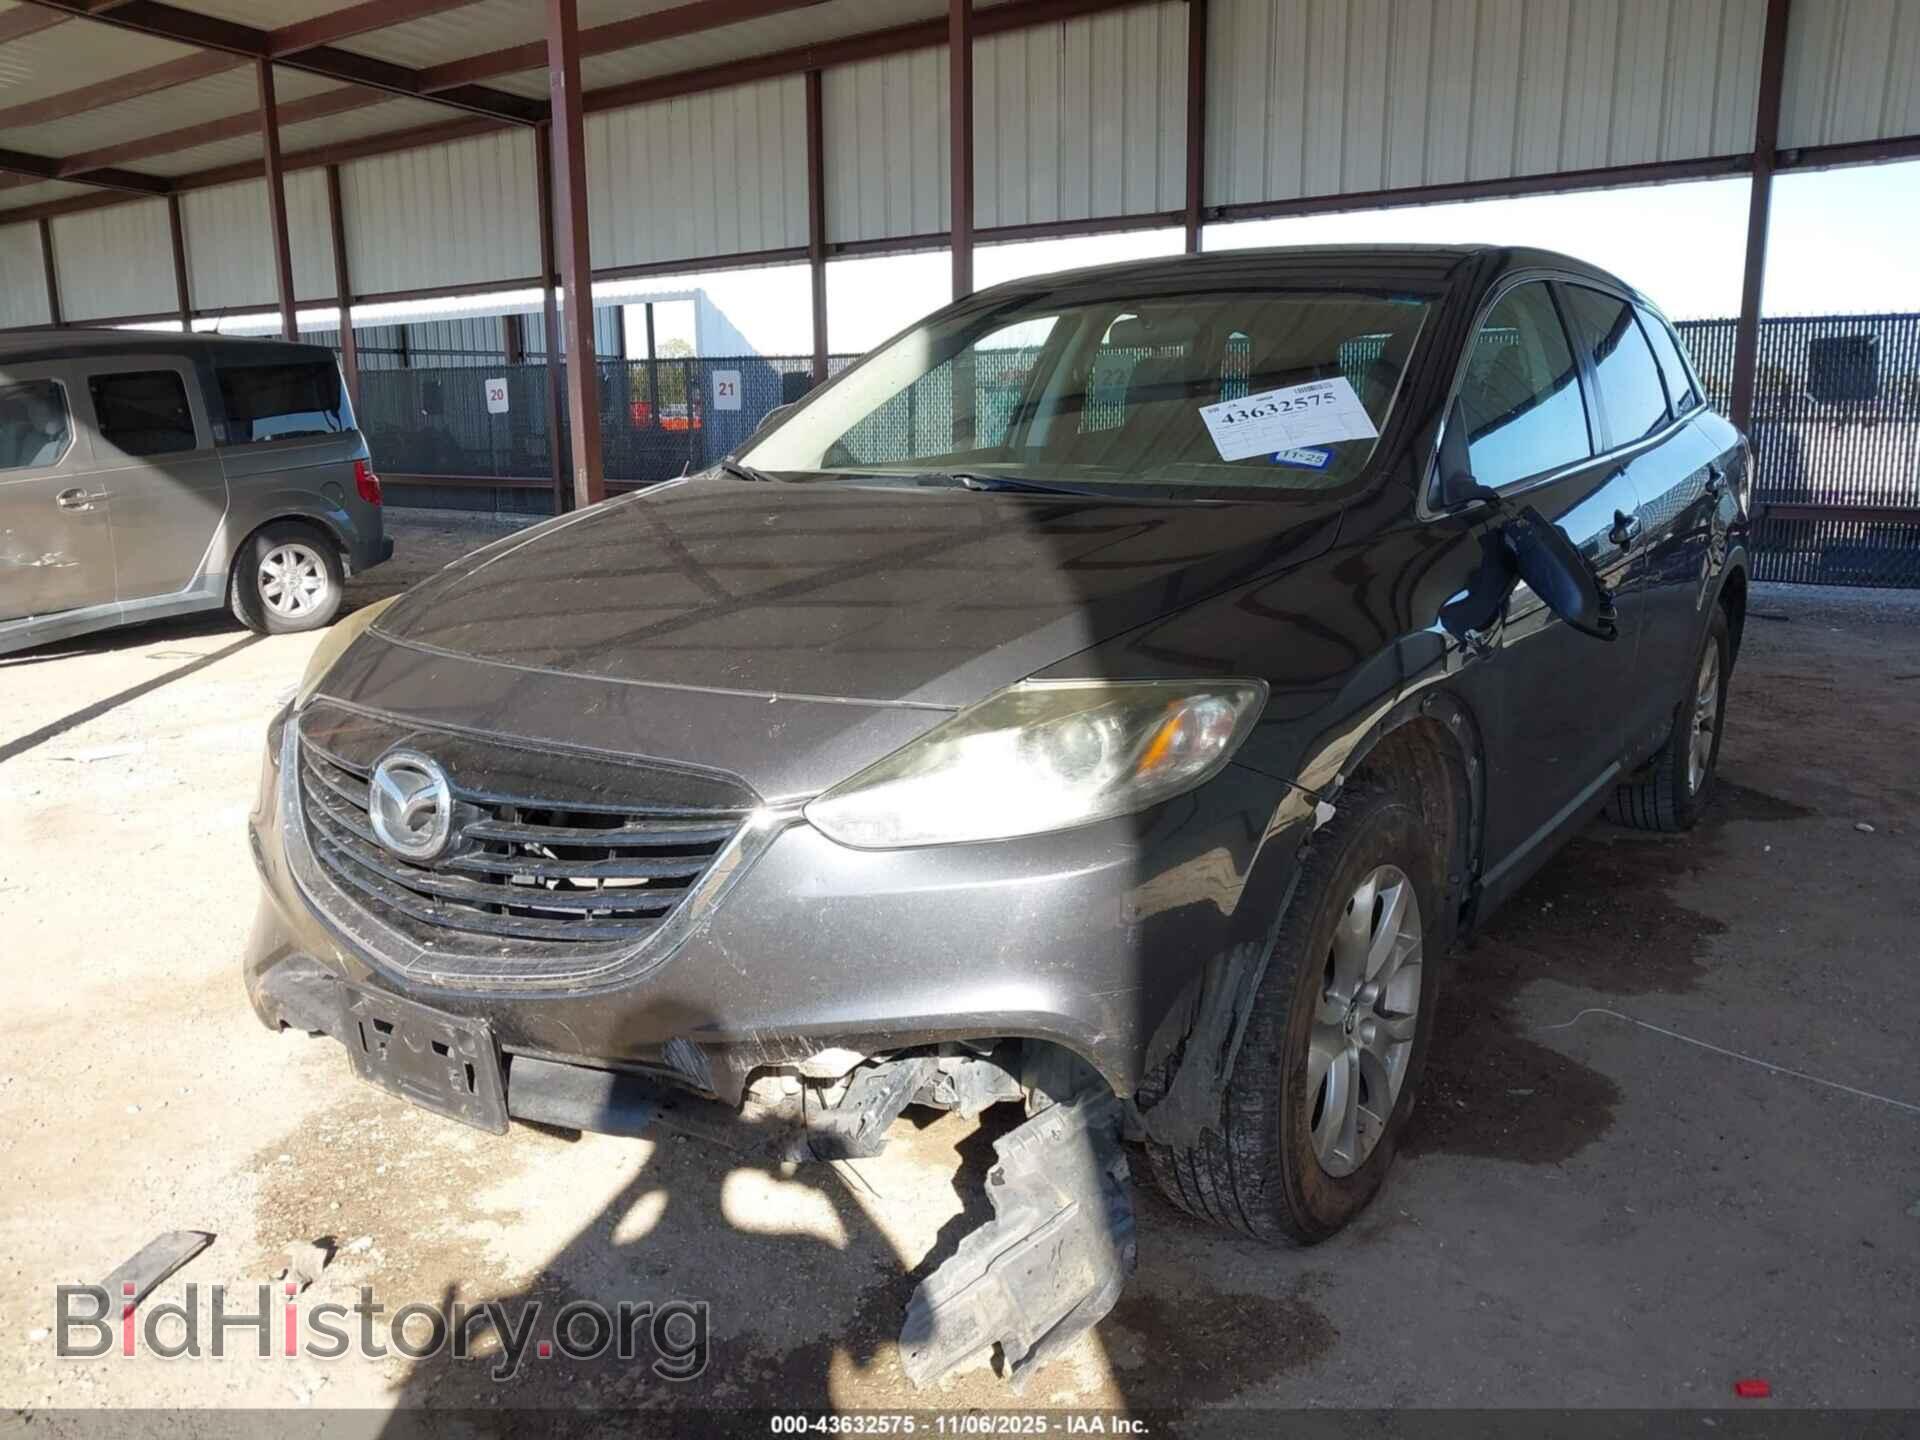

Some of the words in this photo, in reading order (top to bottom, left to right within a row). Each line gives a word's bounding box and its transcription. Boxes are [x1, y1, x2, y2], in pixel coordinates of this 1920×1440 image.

[490, 388, 504, 401] 20
[719, 382, 735, 396] 21
[1221, 391, 1337, 424] 43632575
